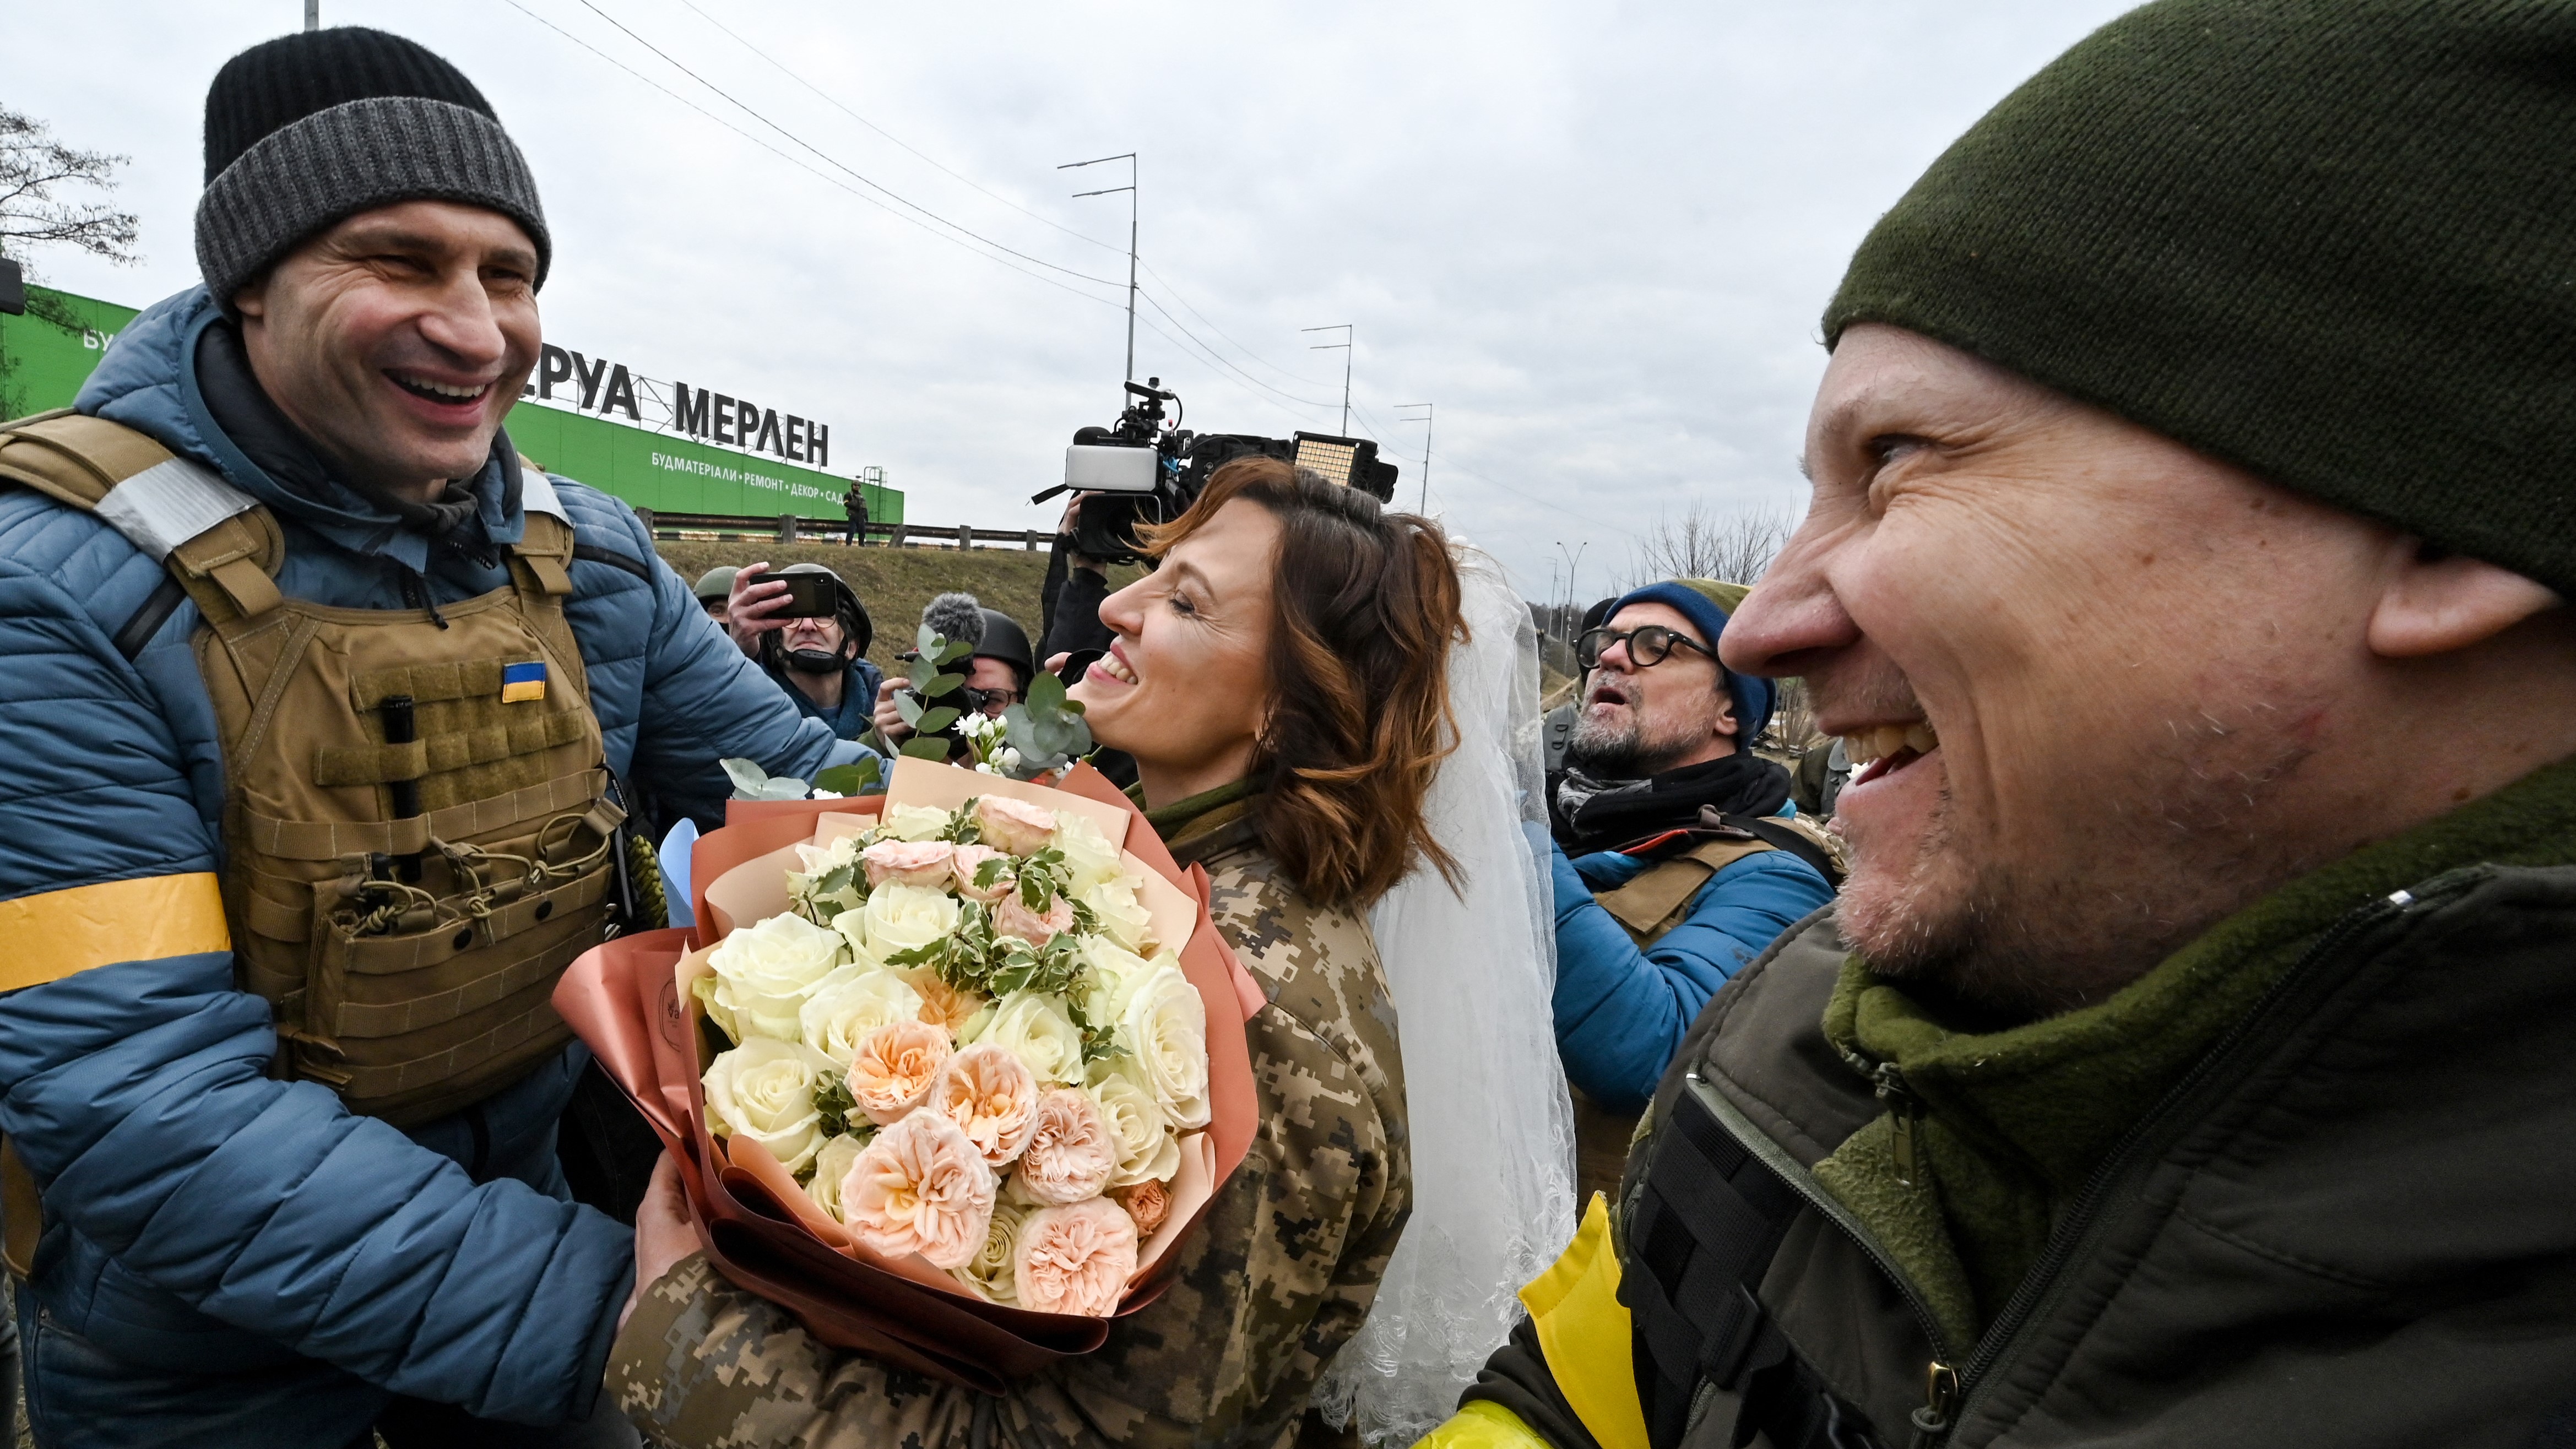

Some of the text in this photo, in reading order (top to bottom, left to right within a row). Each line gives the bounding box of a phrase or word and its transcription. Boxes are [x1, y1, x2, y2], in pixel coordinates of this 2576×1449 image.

[524, 342, 828, 467] РУА МЕРЛЕН
[652, 452, 844, 506] БУДМАТЕРІАЛИ РЕМОНТ ДЕКОР САД
